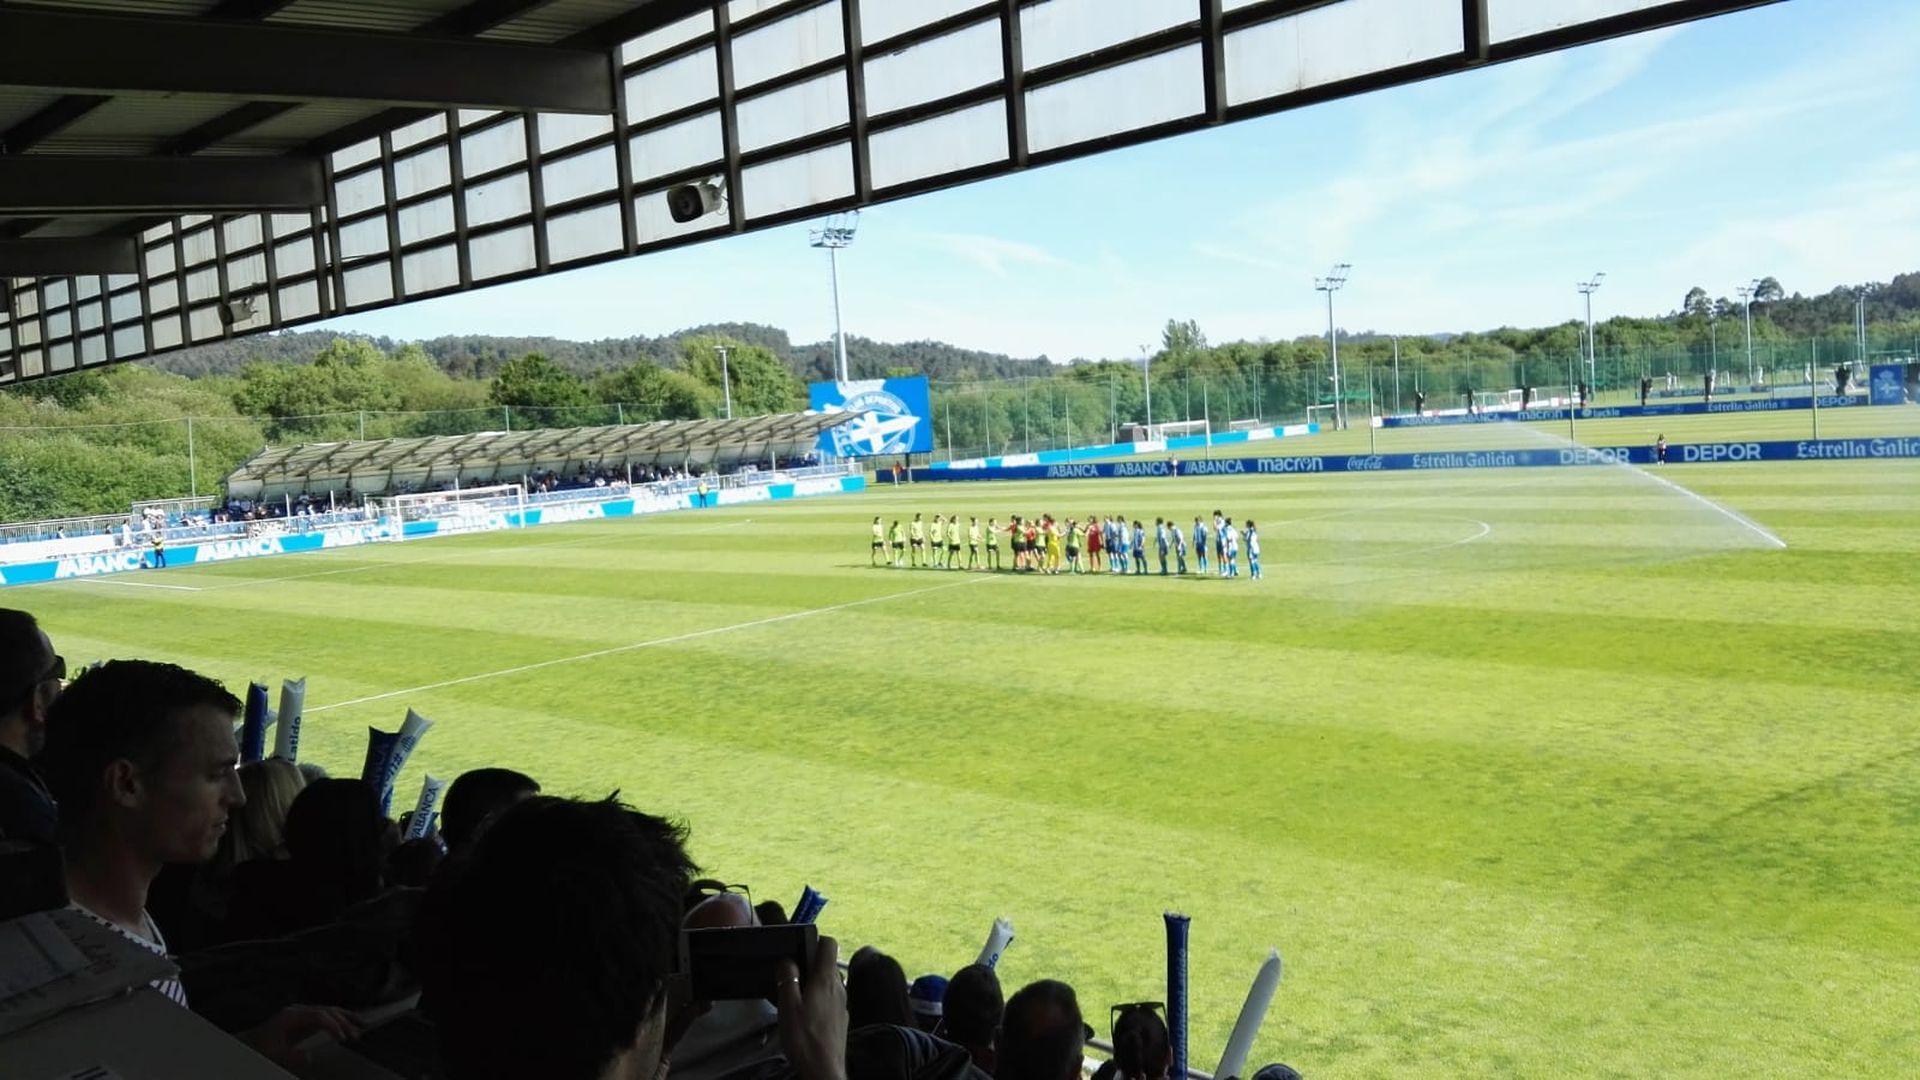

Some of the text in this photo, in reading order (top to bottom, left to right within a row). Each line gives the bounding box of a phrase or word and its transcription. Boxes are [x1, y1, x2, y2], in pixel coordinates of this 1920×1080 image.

[1560, 447, 1630, 465] DEPOR
[1683, 444, 1761, 461] DEPOR
[1797, 440, 1866, 458] Estrella
[1258, 456, 1324, 472] macron
[1413, 451, 1516, 468] Estrella Galicia
